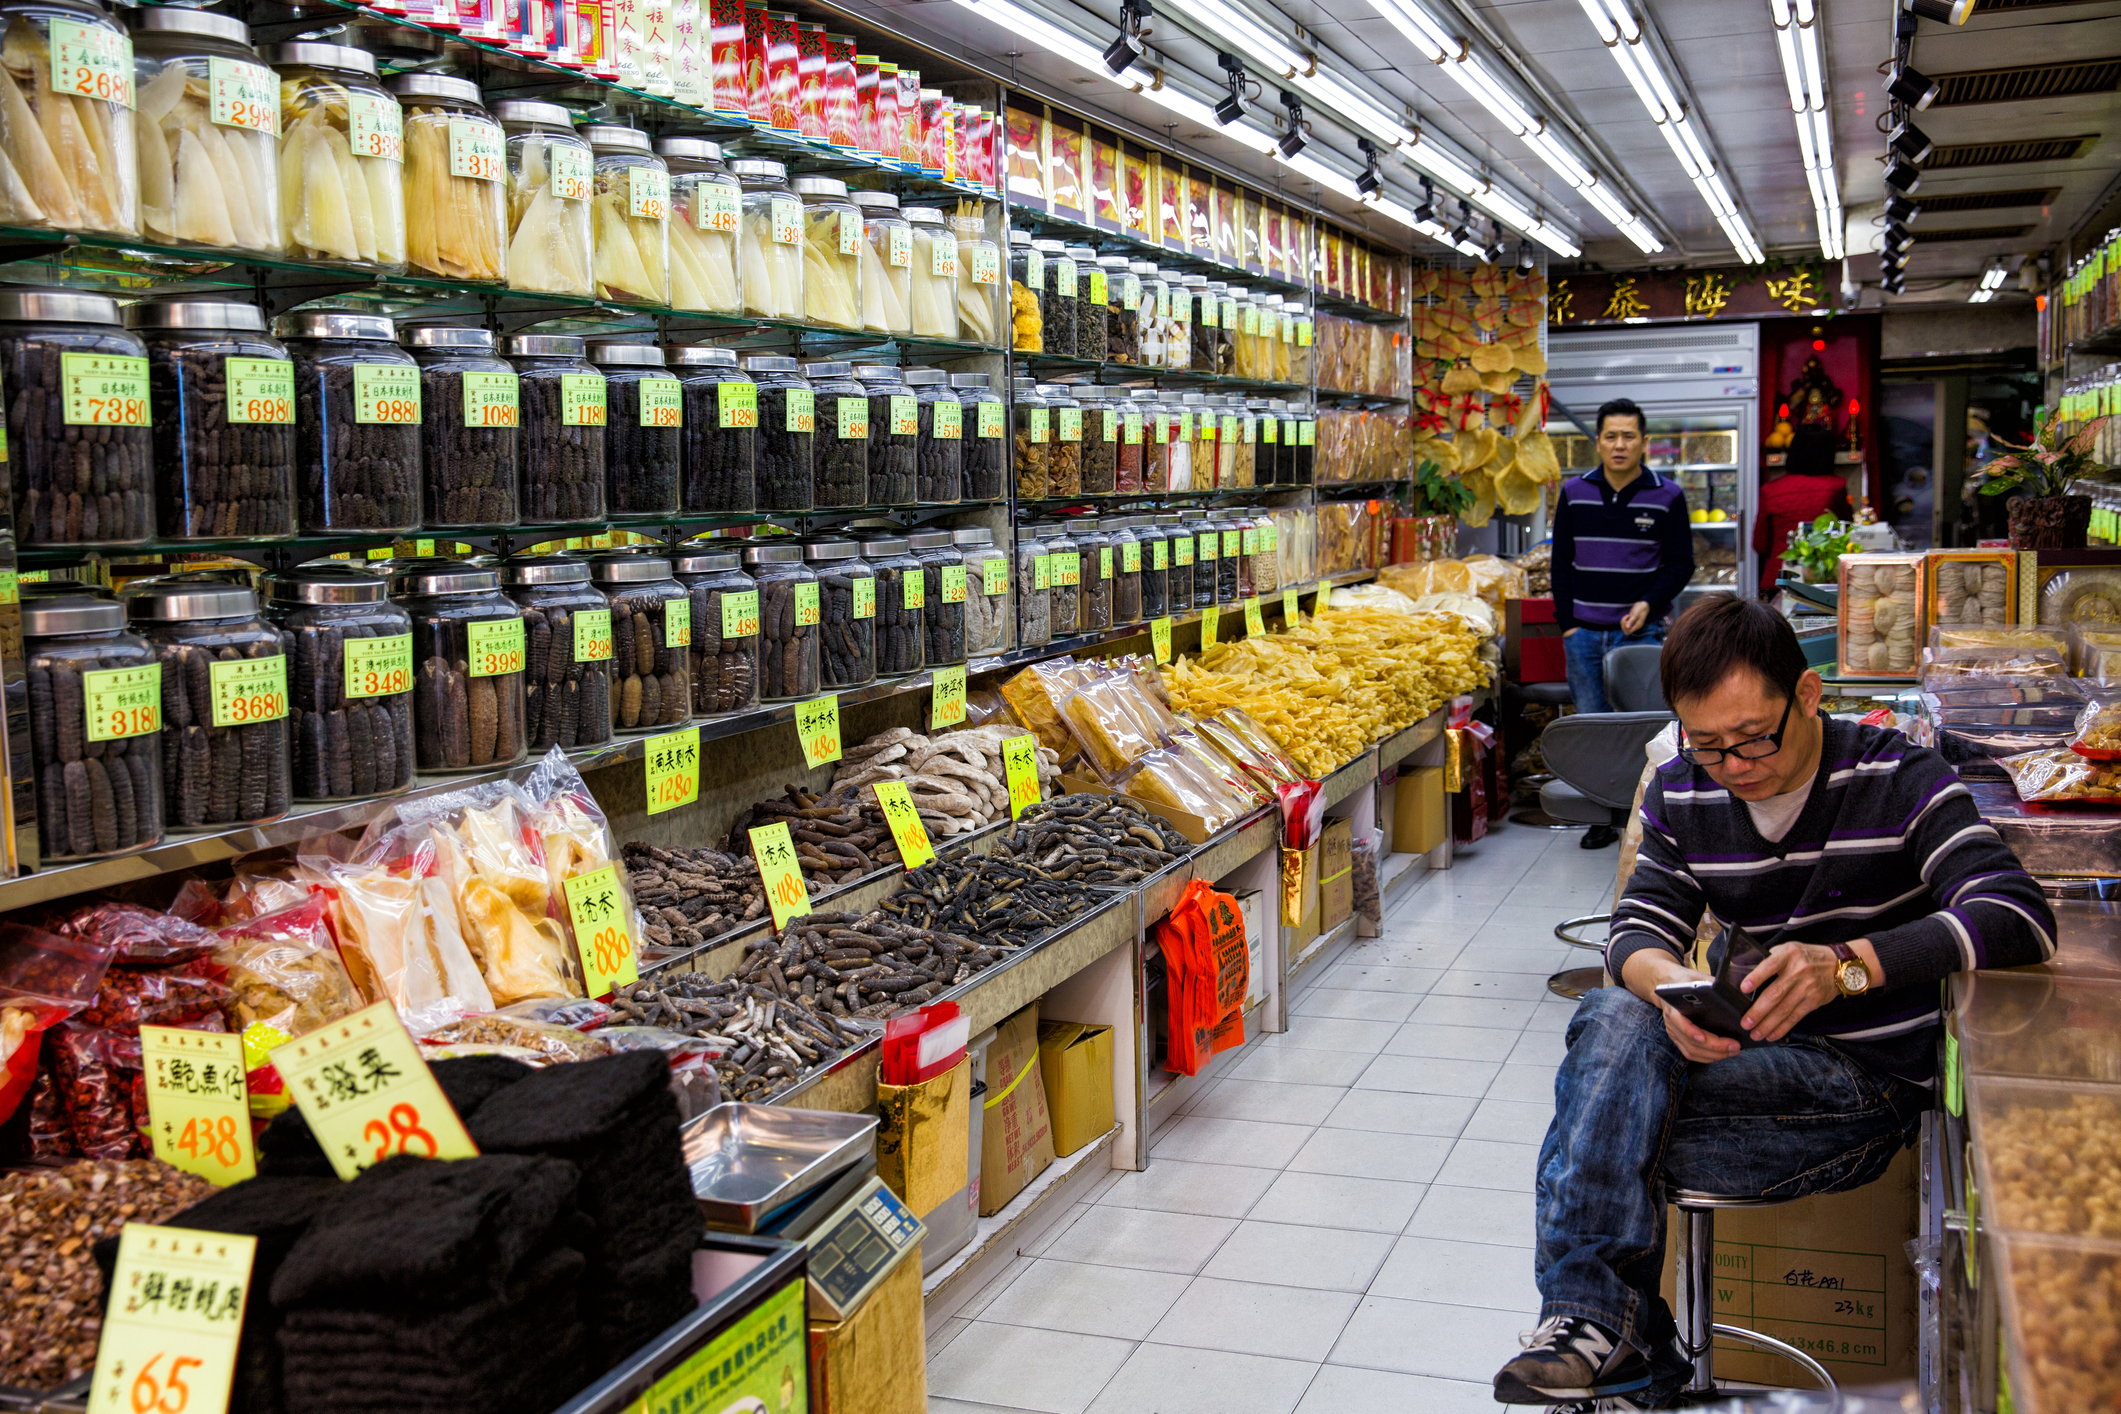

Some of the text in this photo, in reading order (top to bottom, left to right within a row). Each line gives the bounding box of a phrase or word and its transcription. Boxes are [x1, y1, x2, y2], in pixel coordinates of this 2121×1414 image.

[76, 68, 132, 106] 2680
[231, 101, 278, 134] 2980
[467, 154, 505, 182] 3180
[89, 398, 147, 425] 7380
[248, 398, 292, 423] 6980
[376, 400, 418, 422] 9880
[486, 650, 523, 674] 3980
[588, 638, 611, 659] 298
[365, 668, 410, 694] 3480
[111, 706, 158, 735] 3180
[232, 692, 284, 722] 3680
[809, 734, 837, 760] 1480
[659, 773, 692, 805] 1280
[1016, 777, 1039, 804] 1380
[903, 823, 927, 851] 1080
[776, 872, 804, 907] 1180
[594, 926, 631, 976] 880
[177, 1114, 242, 1168] 438
[1714, 1253, 1748, 1269] ODITY
[1856, 1300, 1874, 1318] kg
[1569, 1322, 1614, 1373] N
[1853, 1344, 1876, 1355] cm
[130, 1352, 204, 1414] 65
